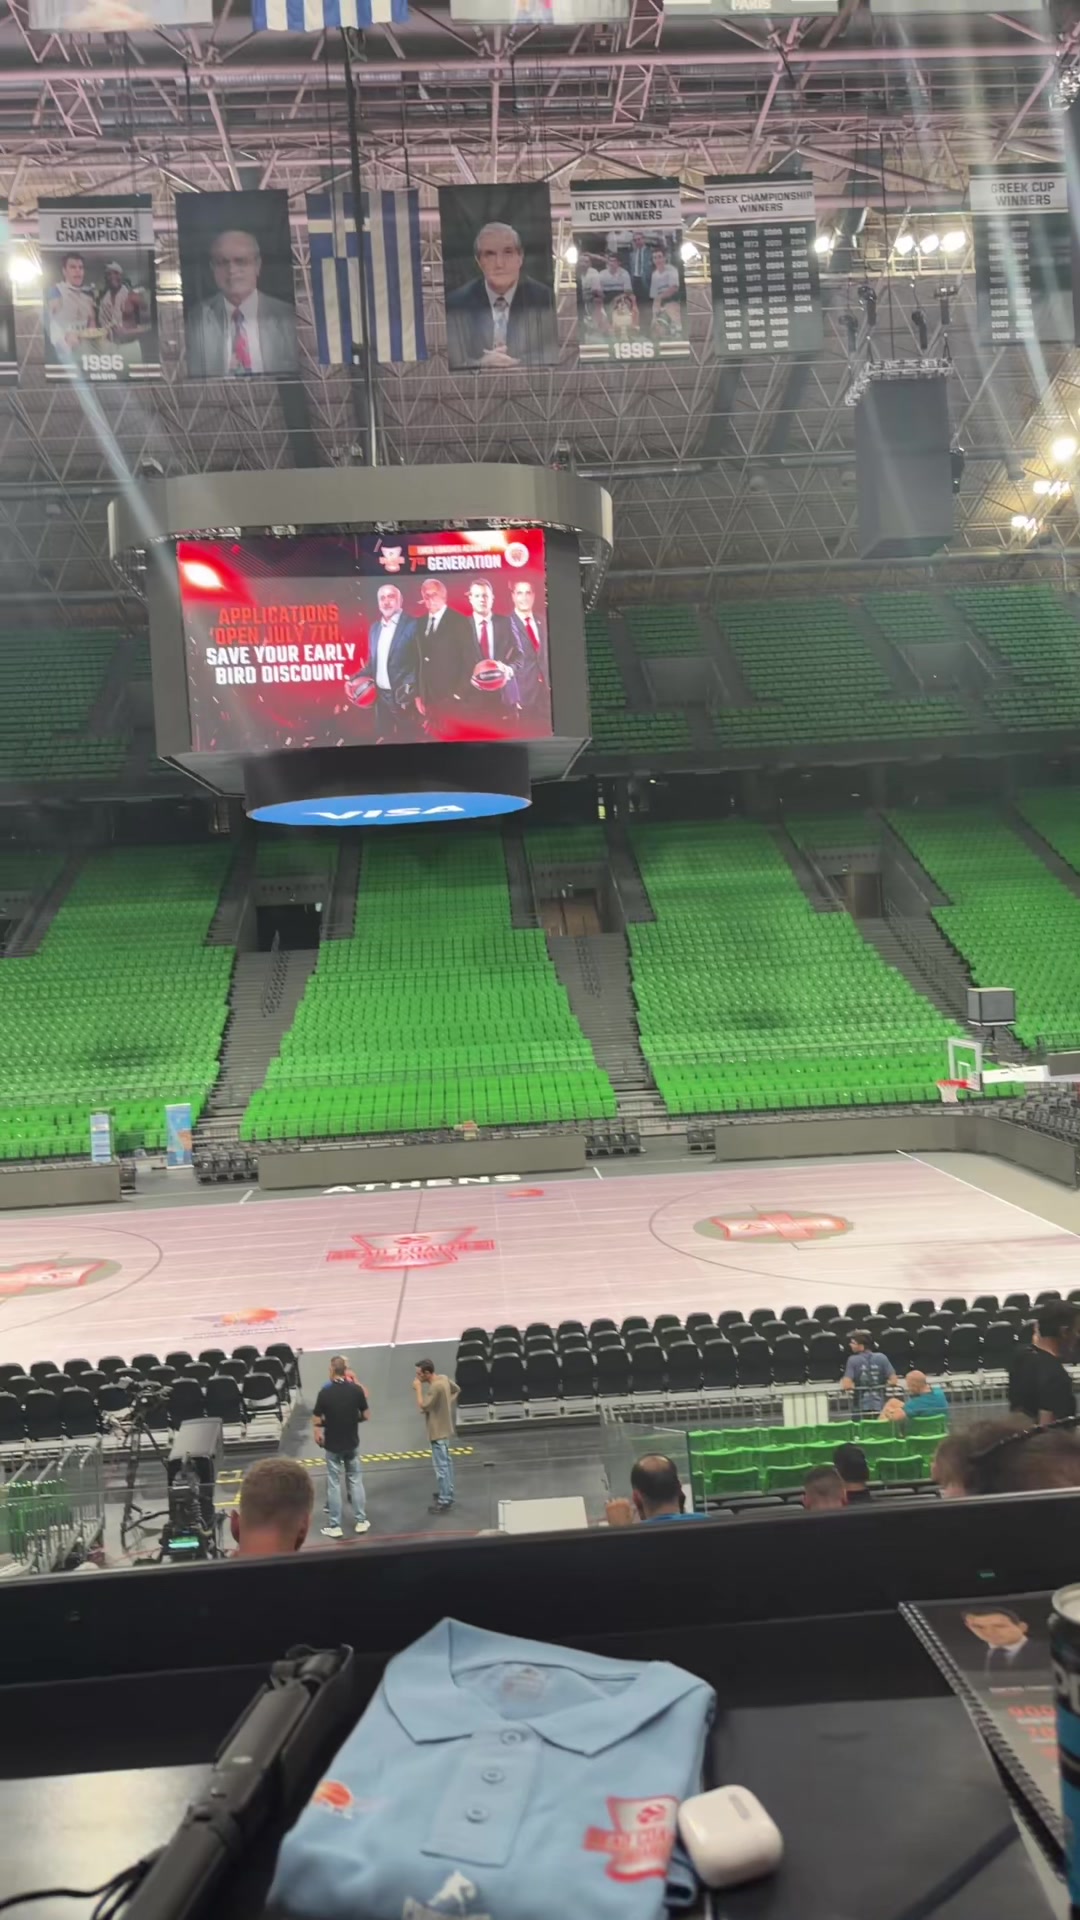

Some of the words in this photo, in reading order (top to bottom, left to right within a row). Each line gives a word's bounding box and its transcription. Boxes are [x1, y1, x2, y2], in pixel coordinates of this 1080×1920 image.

[991, 183, 1029, 193] GREEK
[1031, 181, 1055, 192] CUP
[575, 199, 676, 212] INTERCONTINENTAL
[707, 194, 738, 205] GREEK
[740, 191, 813, 203] CHAMPIONSHIP
[995, 194, 1051, 206] WINNERS
[738, 202, 784, 213] WINNERS
[61, 216, 133, 230] EUROPEAN
[589, 211, 610, 222] CUP
[613, 210, 663, 222] WINNERS
[56, 229, 139, 243] CHAMPIONS
[613, 342, 655, 359] 1996
[81, 354, 124, 372] 1996
[427, 554, 502, 571] GENERATION
[218, 604, 339, 625] APPLICATIONS
[215, 626, 259, 645] OPEN
[264, 625, 304, 644] JULY
[206, 646, 250, 666] SAVE
[254, 645, 300, 664] YOUR
[303, 643, 356, 662] EARLY
[215, 665, 257, 685] BIRD
[261, 663, 351, 683] DISCOUNT.
[303, 804, 465, 820] VISA
[322, 1174, 522, 1194] ATHENS
